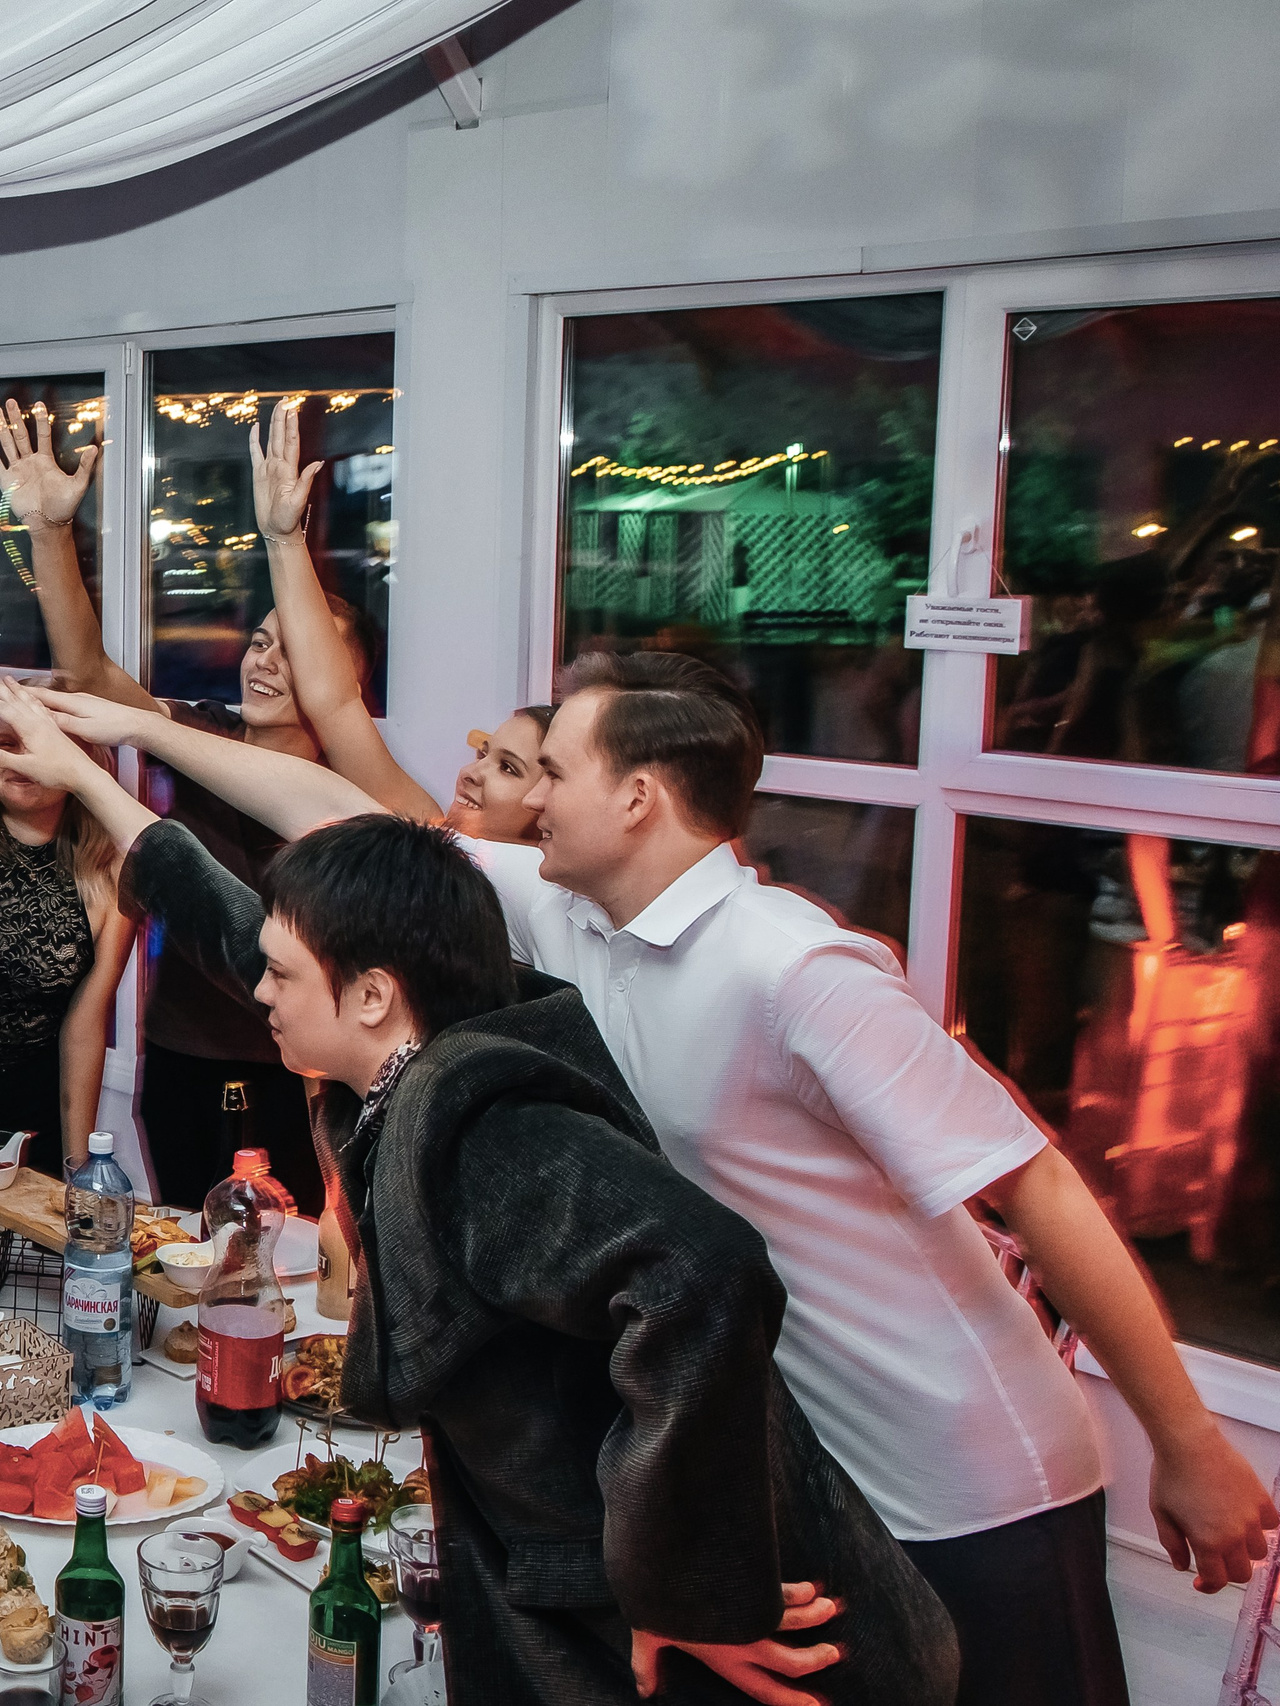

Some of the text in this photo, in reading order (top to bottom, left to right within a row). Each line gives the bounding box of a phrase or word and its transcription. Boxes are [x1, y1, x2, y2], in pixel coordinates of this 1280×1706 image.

[909, 630, 950, 639] Работают
[61, 1623, 111, 1647] HINT
[327, 1646, 353, 1656] MANGO
